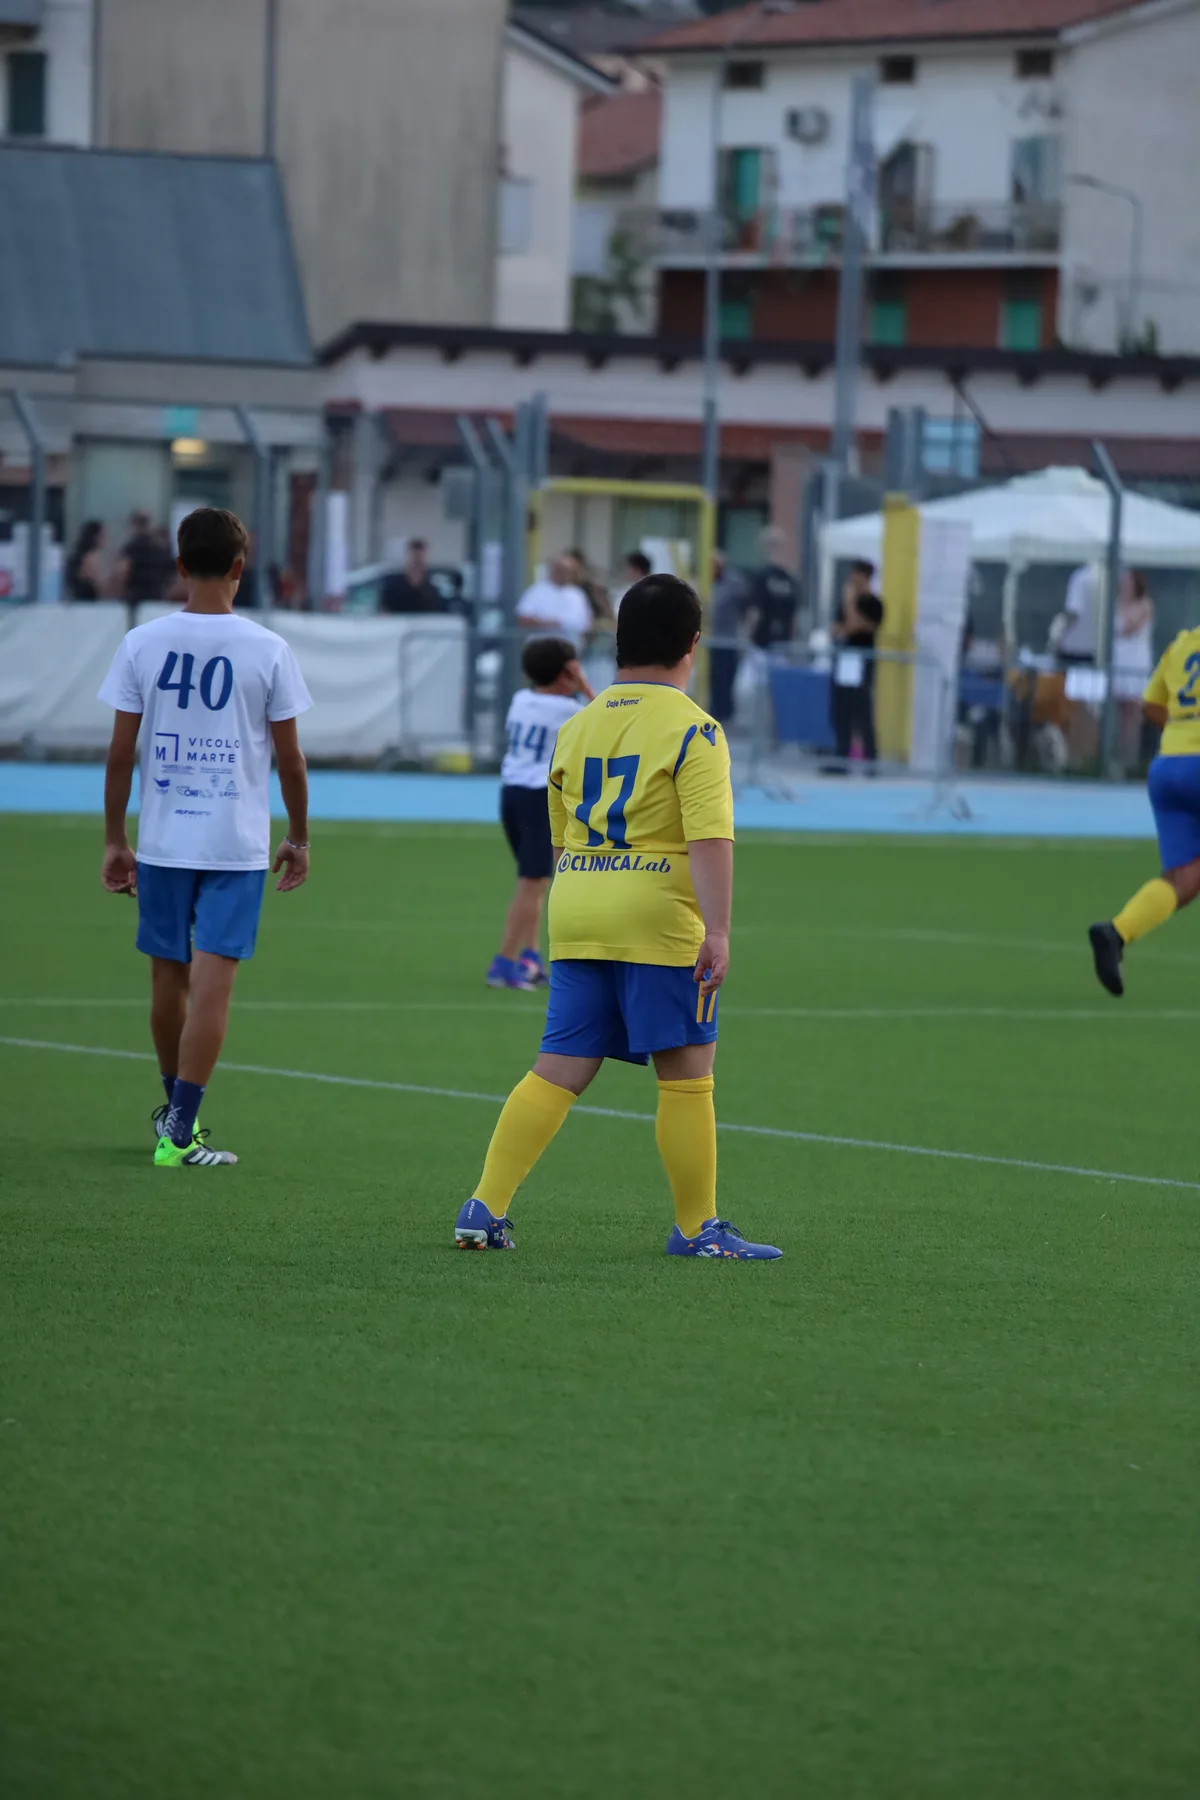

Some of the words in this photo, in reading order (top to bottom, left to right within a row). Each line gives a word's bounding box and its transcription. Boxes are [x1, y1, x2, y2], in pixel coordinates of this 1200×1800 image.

[156, 651, 233, 711] 40
[186, 752, 236, 763] MARTE
[188, 737, 240, 749] VICOLO
[575, 754, 641, 850] 17
